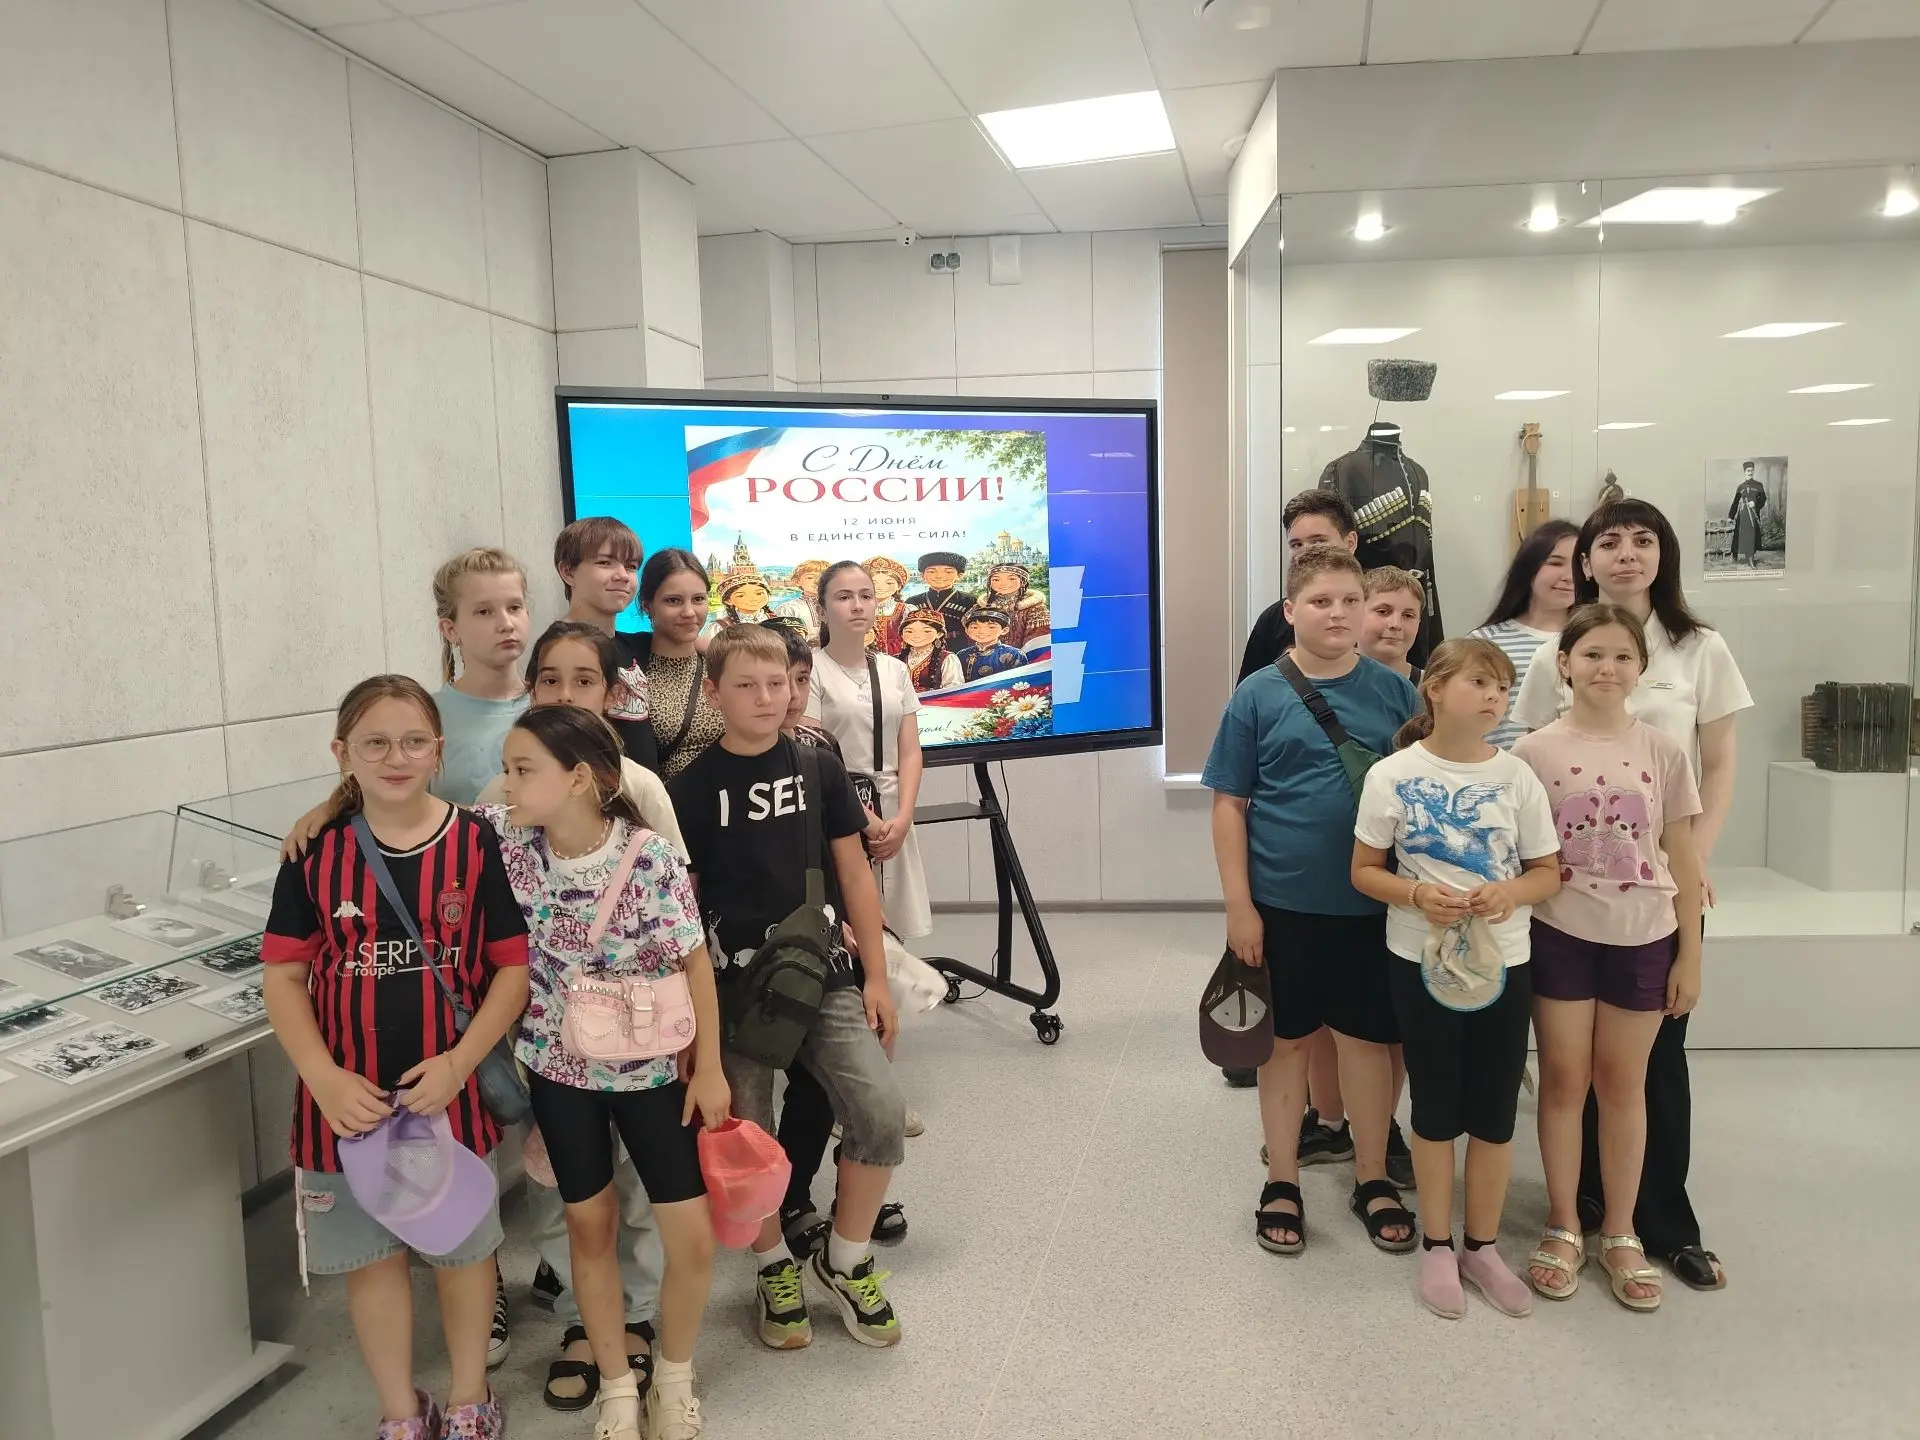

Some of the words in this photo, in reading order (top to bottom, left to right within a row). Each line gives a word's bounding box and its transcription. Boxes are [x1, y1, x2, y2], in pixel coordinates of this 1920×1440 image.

[802, 444, 840, 473] С
[848, 444, 948, 473] Днём
[745, 476, 1004, 504] РОССИИ!
[842, 517, 859, 526] 12
[868, 516, 917, 526] ИЮНЯ
[790, 533, 798, 541] В
[808, 532, 896, 542] ЕДИНСТВЕ
[918, 530, 967, 540] СИЛА!
[719, 788, 729, 827] I
